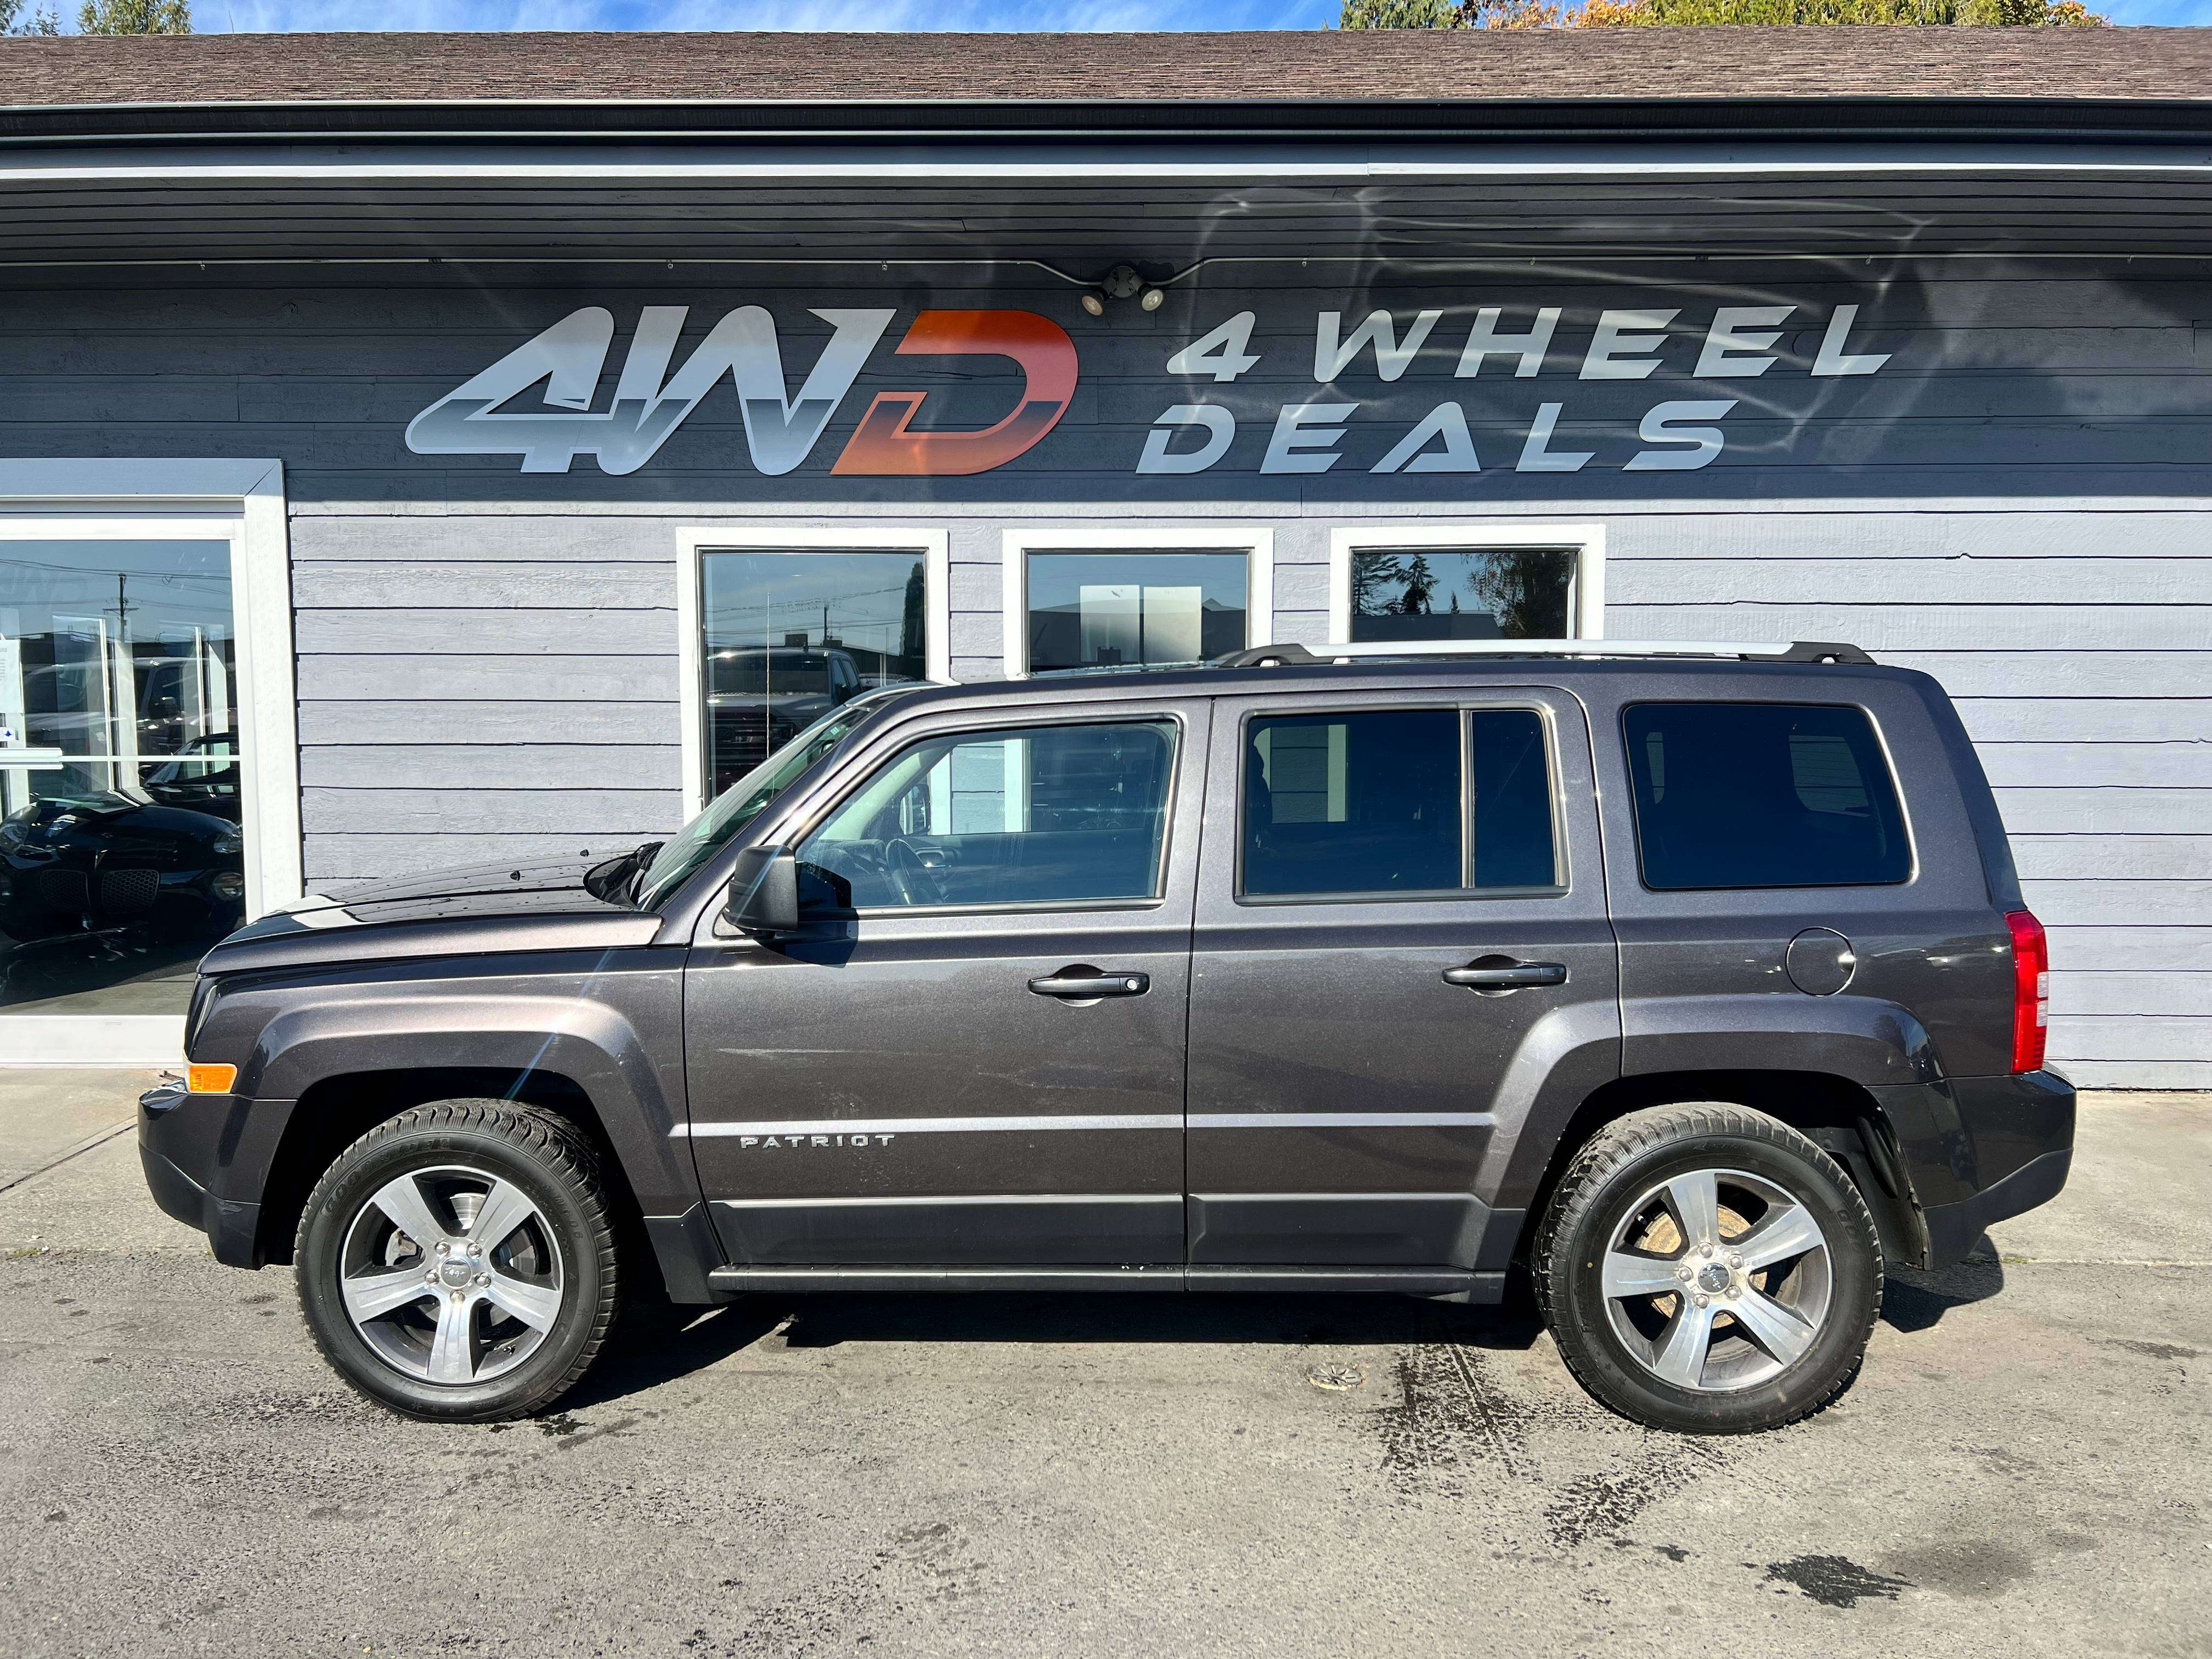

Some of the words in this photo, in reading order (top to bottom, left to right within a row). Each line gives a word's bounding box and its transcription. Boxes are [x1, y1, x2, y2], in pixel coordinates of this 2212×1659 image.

[1166, 311, 1261, 382] 4
[1313, 304, 1893, 383] WHEEL
[405, 305, 1079, 476] 4WD
[1135, 399, 1740, 474] DEALS
[740, 1133, 895, 1149] PATRIOT
